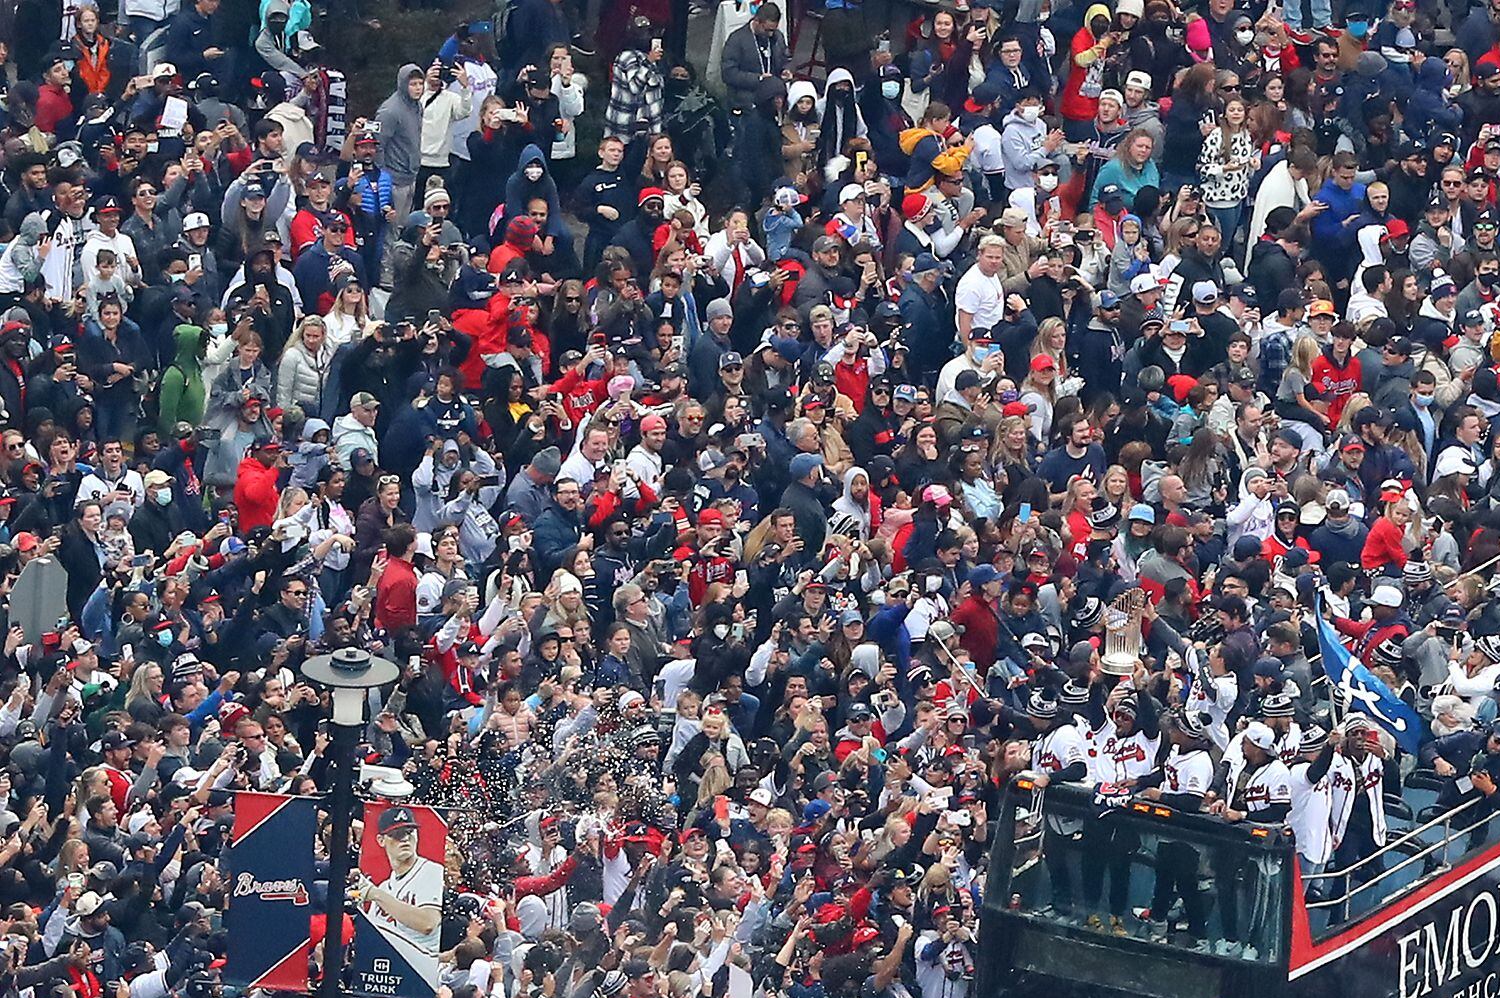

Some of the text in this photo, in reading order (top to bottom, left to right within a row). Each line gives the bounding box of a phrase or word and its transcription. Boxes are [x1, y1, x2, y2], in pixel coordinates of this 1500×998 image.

[234, 872, 300, 898] Braves
[359, 972, 403, 986] TRUIST
[364, 983, 397, 996] PARK
